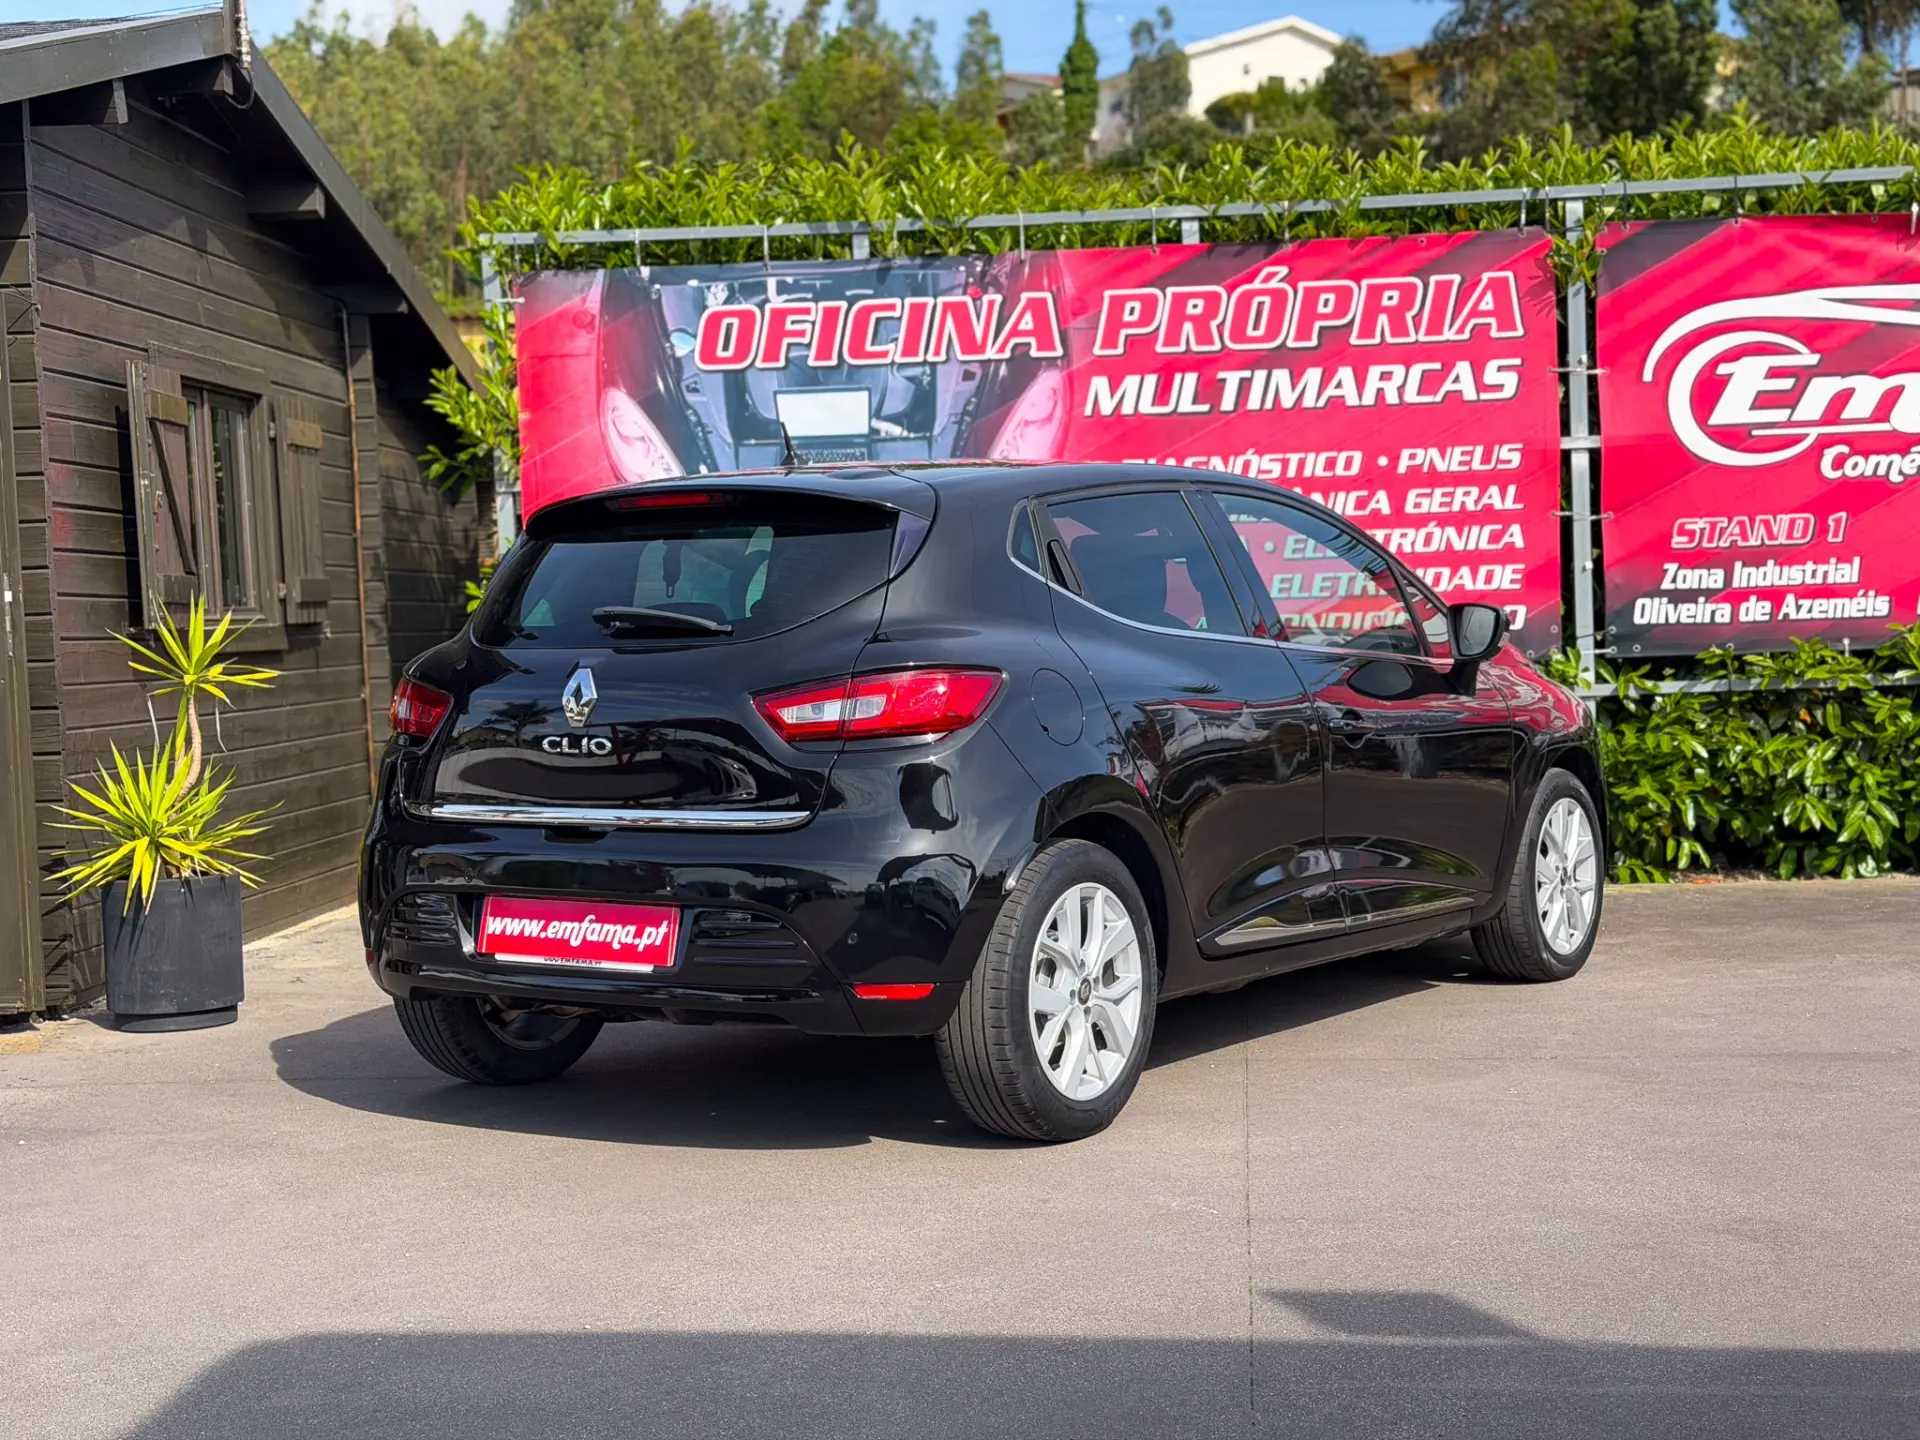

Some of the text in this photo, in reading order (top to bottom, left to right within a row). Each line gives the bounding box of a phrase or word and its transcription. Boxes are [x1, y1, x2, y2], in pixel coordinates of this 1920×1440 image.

[694, 265, 1525, 372] OFICINA PRÓPRIA
[1084, 358, 1523, 417] MULTIMARCAS
[1122, 444, 1524, 480] NÓSTICO PNEUS
[1405, 484, 1525, 512] GERAL
[1671, 512, 1848, 549] STAND 1
[1660, 556, 1861, 590] Zona Industrial
[1633, 597, 1732, 625] Oliveira
[1738, 596, 1772, 623] de
[1778, 588, 1891, 621] Azeméis
[542, 735, 613, 755] CLIO
[487, 914, 669, 951] www.emfama.pt
